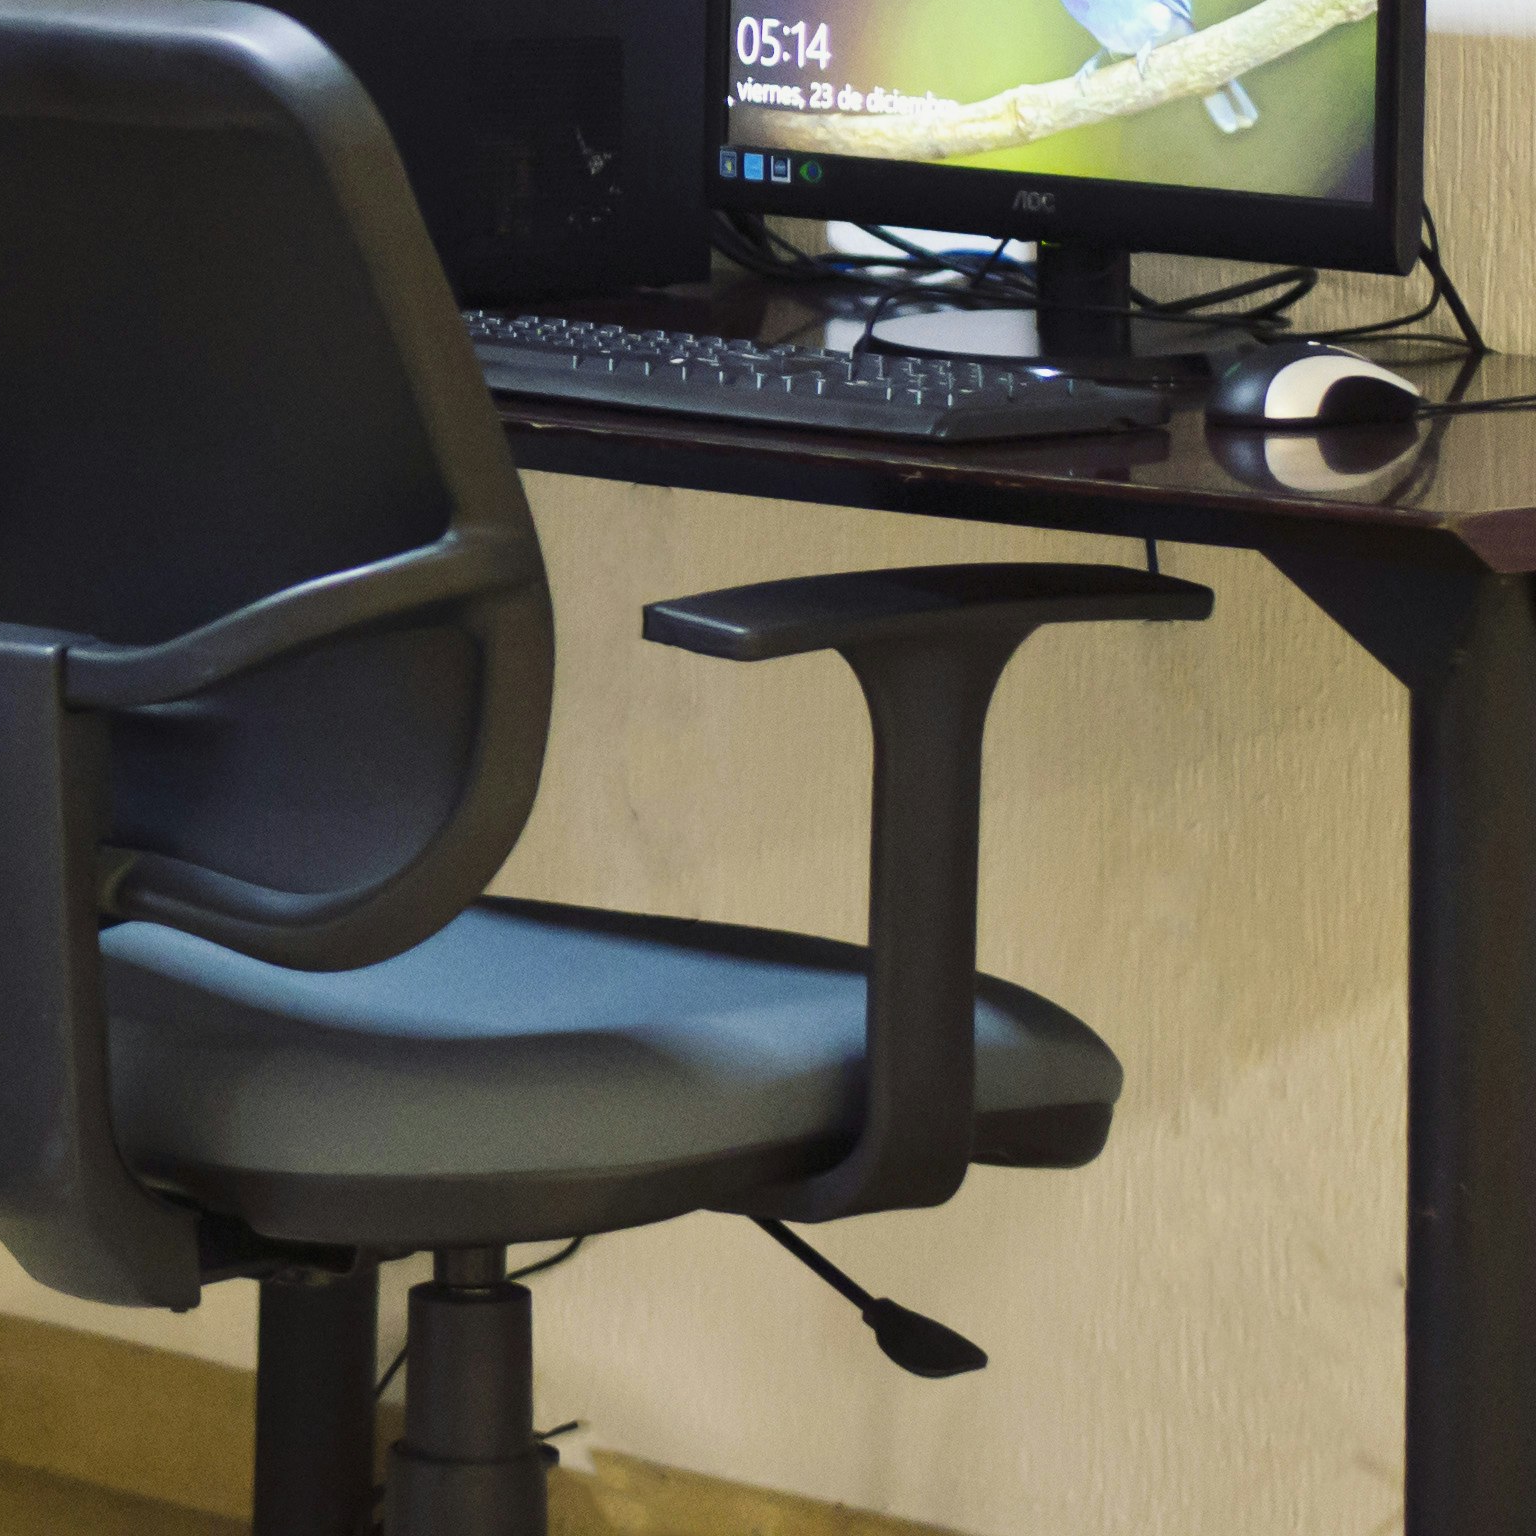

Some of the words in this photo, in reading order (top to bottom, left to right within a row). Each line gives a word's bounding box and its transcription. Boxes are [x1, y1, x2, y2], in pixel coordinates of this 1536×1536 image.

[737, 16, 831, 70] 05:14
[736, 77, 807, 110] viernes,
[809, 81, 835, 109] 23
[837, 83, 864, 112] de
